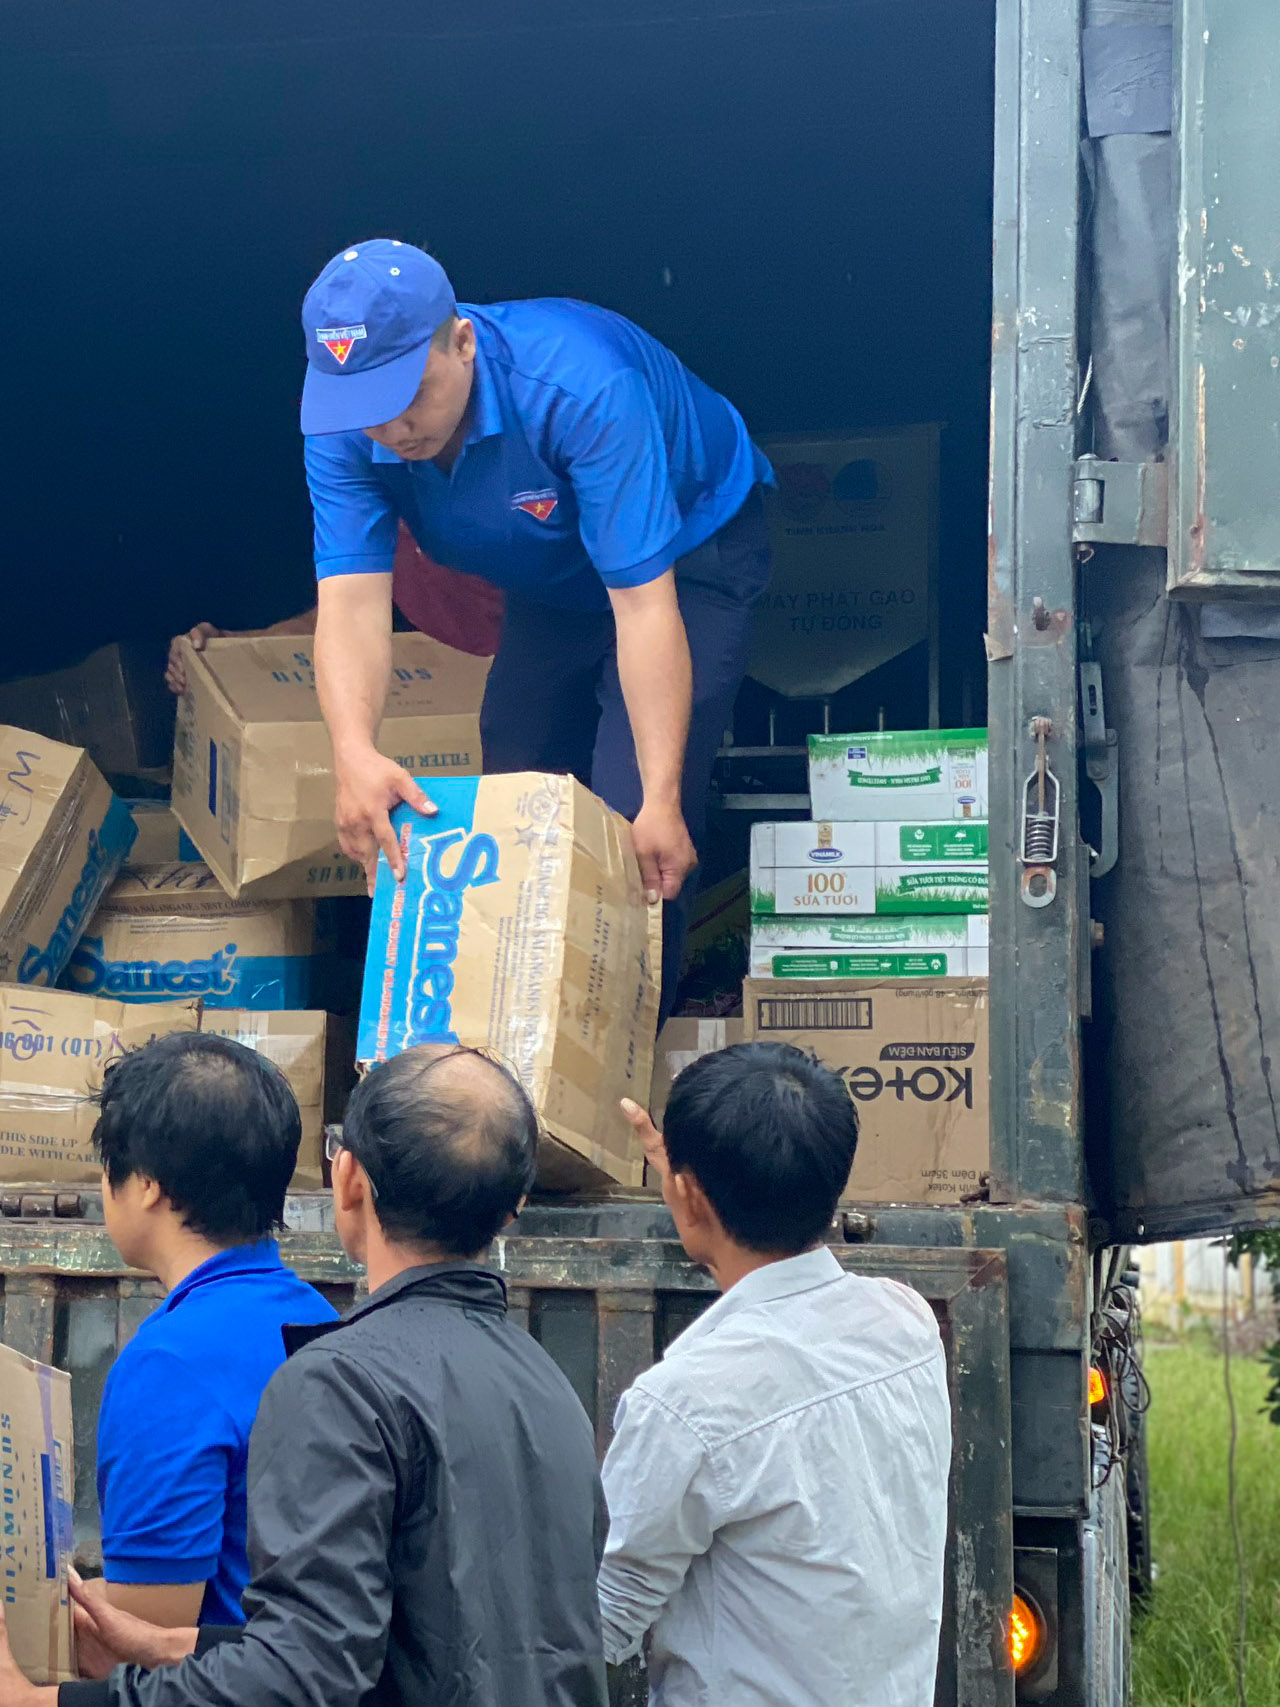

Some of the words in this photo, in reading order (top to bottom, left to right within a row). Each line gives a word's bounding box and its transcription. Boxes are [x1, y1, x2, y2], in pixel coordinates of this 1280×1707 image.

[419, 753, 470, 768] FILTER
[810, 850, 842, 860] VINAMILK
[385, 920, 401, 967] QUALITY
[62, 1036, 103, 1058] (QT)
[917, 1046, 940, 1056] BAN
[942, 1046, 967, 1058] SIÊU
[28, 1134, 57, 1146] SIDE
[62, 1137, 78, 1148] UP
[29, 1148, 63, 1161] WITH
[927, 1183, 956, 1193] Kotex
[1, 1413, 16, 1603] DIAMONDS
